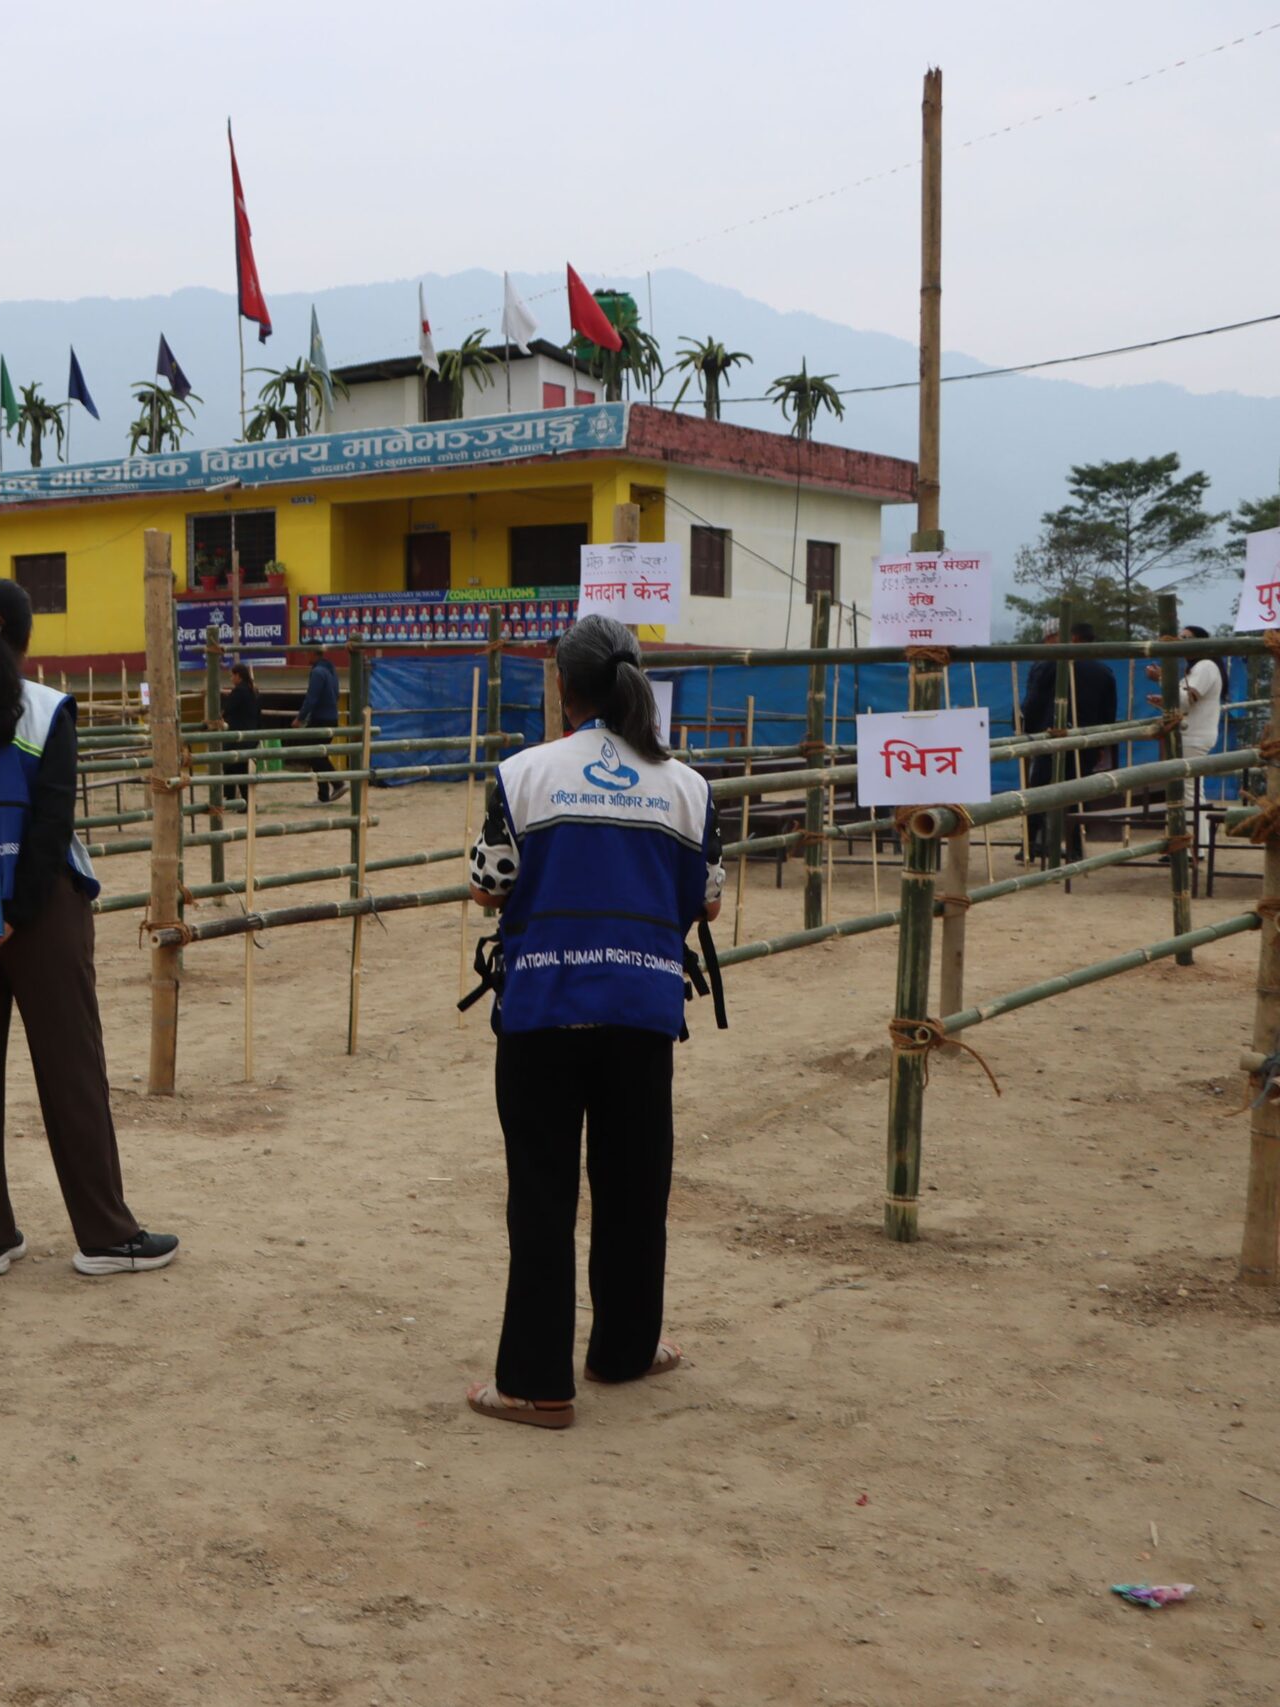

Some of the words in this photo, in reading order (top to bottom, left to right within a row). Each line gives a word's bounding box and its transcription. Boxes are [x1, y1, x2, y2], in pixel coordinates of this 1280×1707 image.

[49, 456, 190, 487] माध्यमिक
[200, 441, 331, 474] विद्यालय
[880, 562, 912, 574] मतदाता
[915, 560, 938, 571] क्रम
[943, 557, 981, 571] संख्या
[449, 586, 536, 601] CONGRATULATIONS
[584, 582, 627, 602] मतदान
[631, 575, 672, 603] केन्द्र
[908, 592, 935, 606] देखि
[244, 622, 282, 638] विद्यालय
[909, 629, 933, 639] सम्म
[880, 739, 963, 778] भित्र
[608, 793, 643, 808] अधिकार
[515, 951, 560, 972] NATIONAL
[564, 949, 603, 965] HUMAN
[606, 948, 642, 967] RIGHTS
